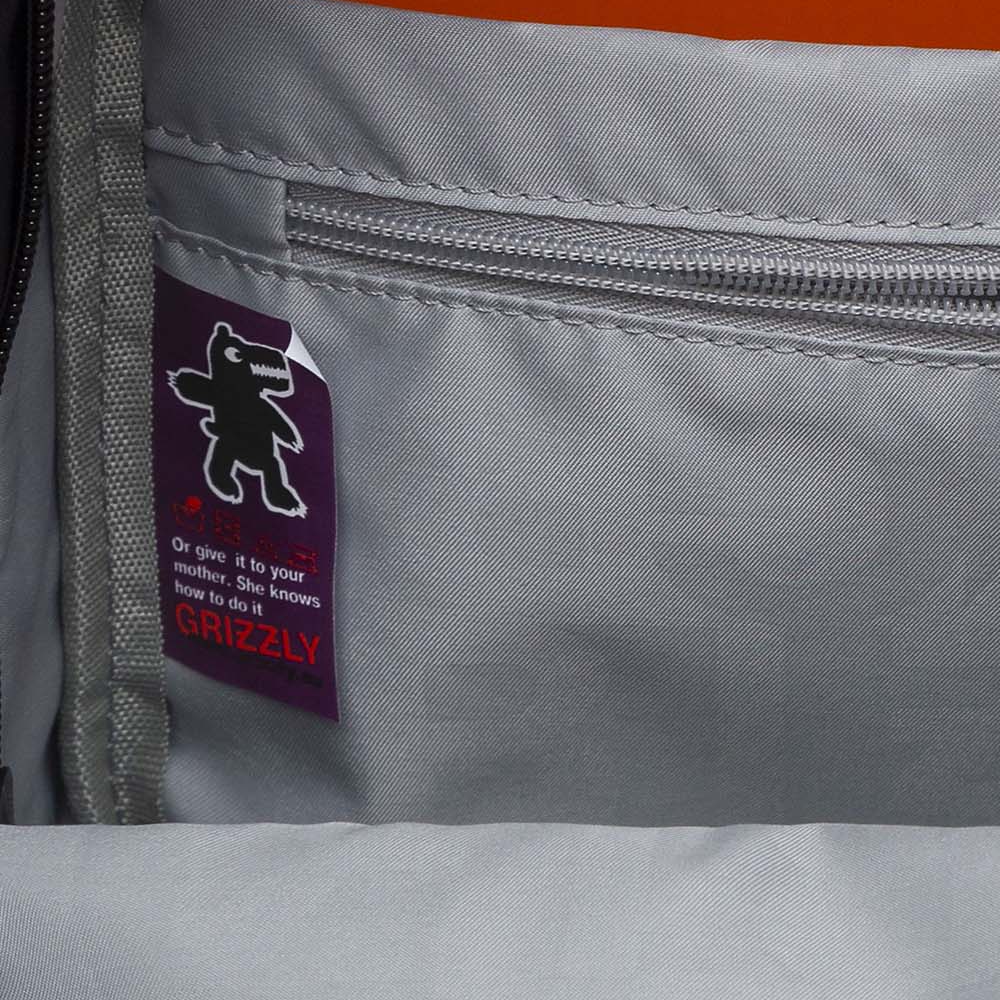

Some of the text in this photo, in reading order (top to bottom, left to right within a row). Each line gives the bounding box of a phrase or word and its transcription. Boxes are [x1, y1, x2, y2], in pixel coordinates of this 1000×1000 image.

[172, 537, 305, 583] Or give it to your
[174, 561, 321, 608] mother. She knows
[175, 580, 263, 616] how to do it
[175, 602, 321, 665] GRIZZLY
